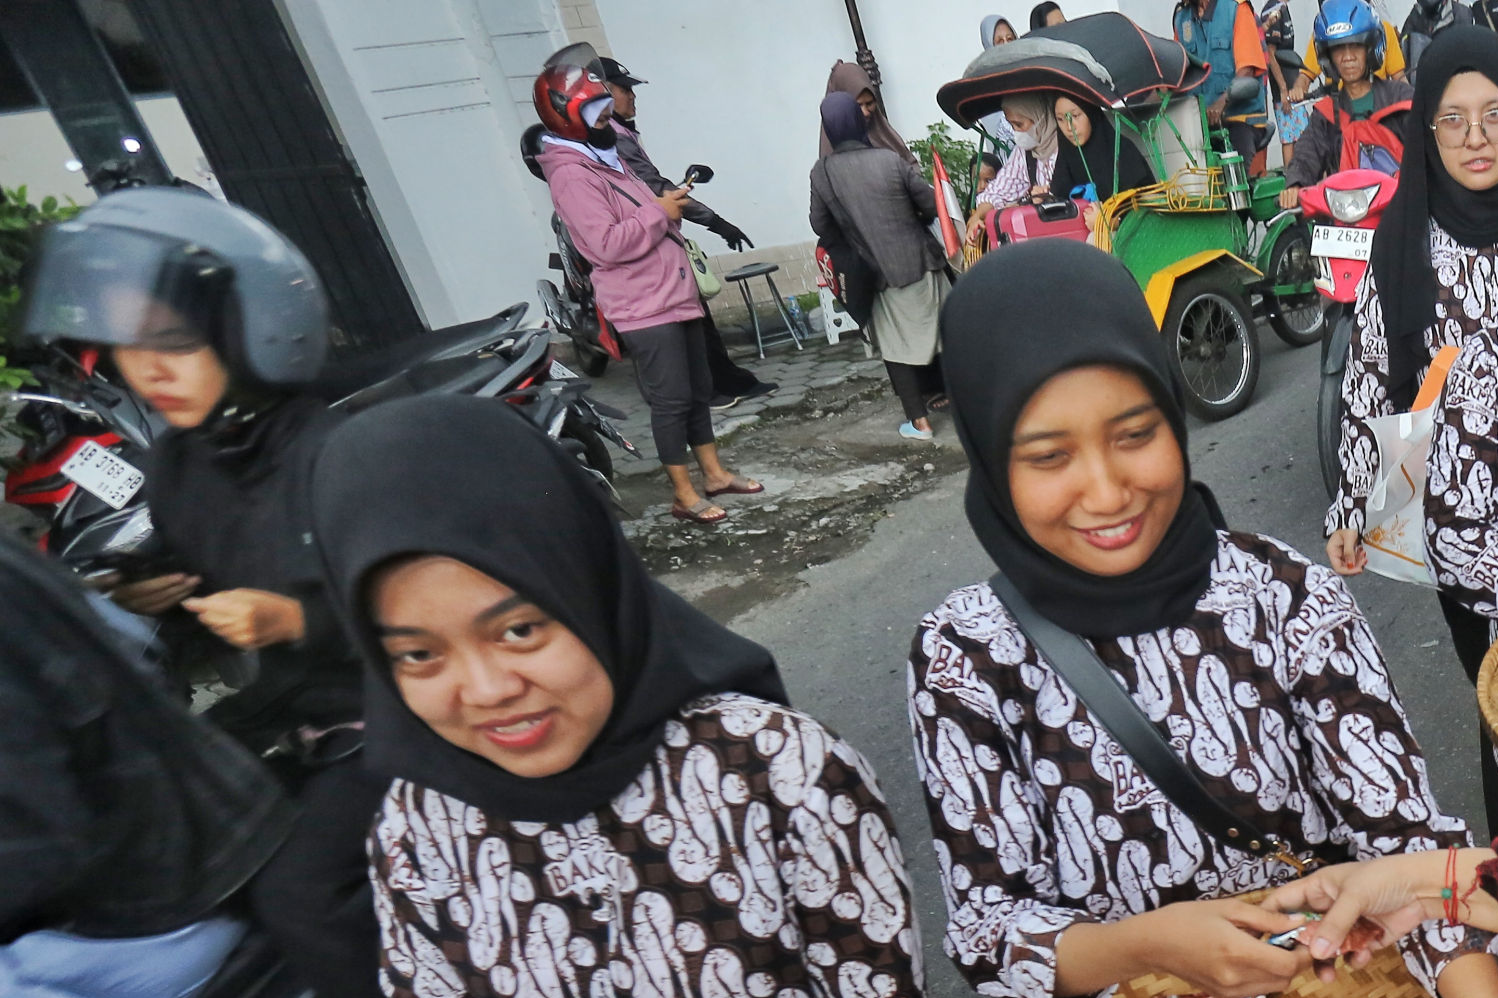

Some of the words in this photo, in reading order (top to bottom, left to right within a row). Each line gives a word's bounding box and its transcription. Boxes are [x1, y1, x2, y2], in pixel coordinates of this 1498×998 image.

[1314, 228, 1329, 240] AB
[1337, 230, 1368, 243] 2628
[79, 445, 97, 461] AB
